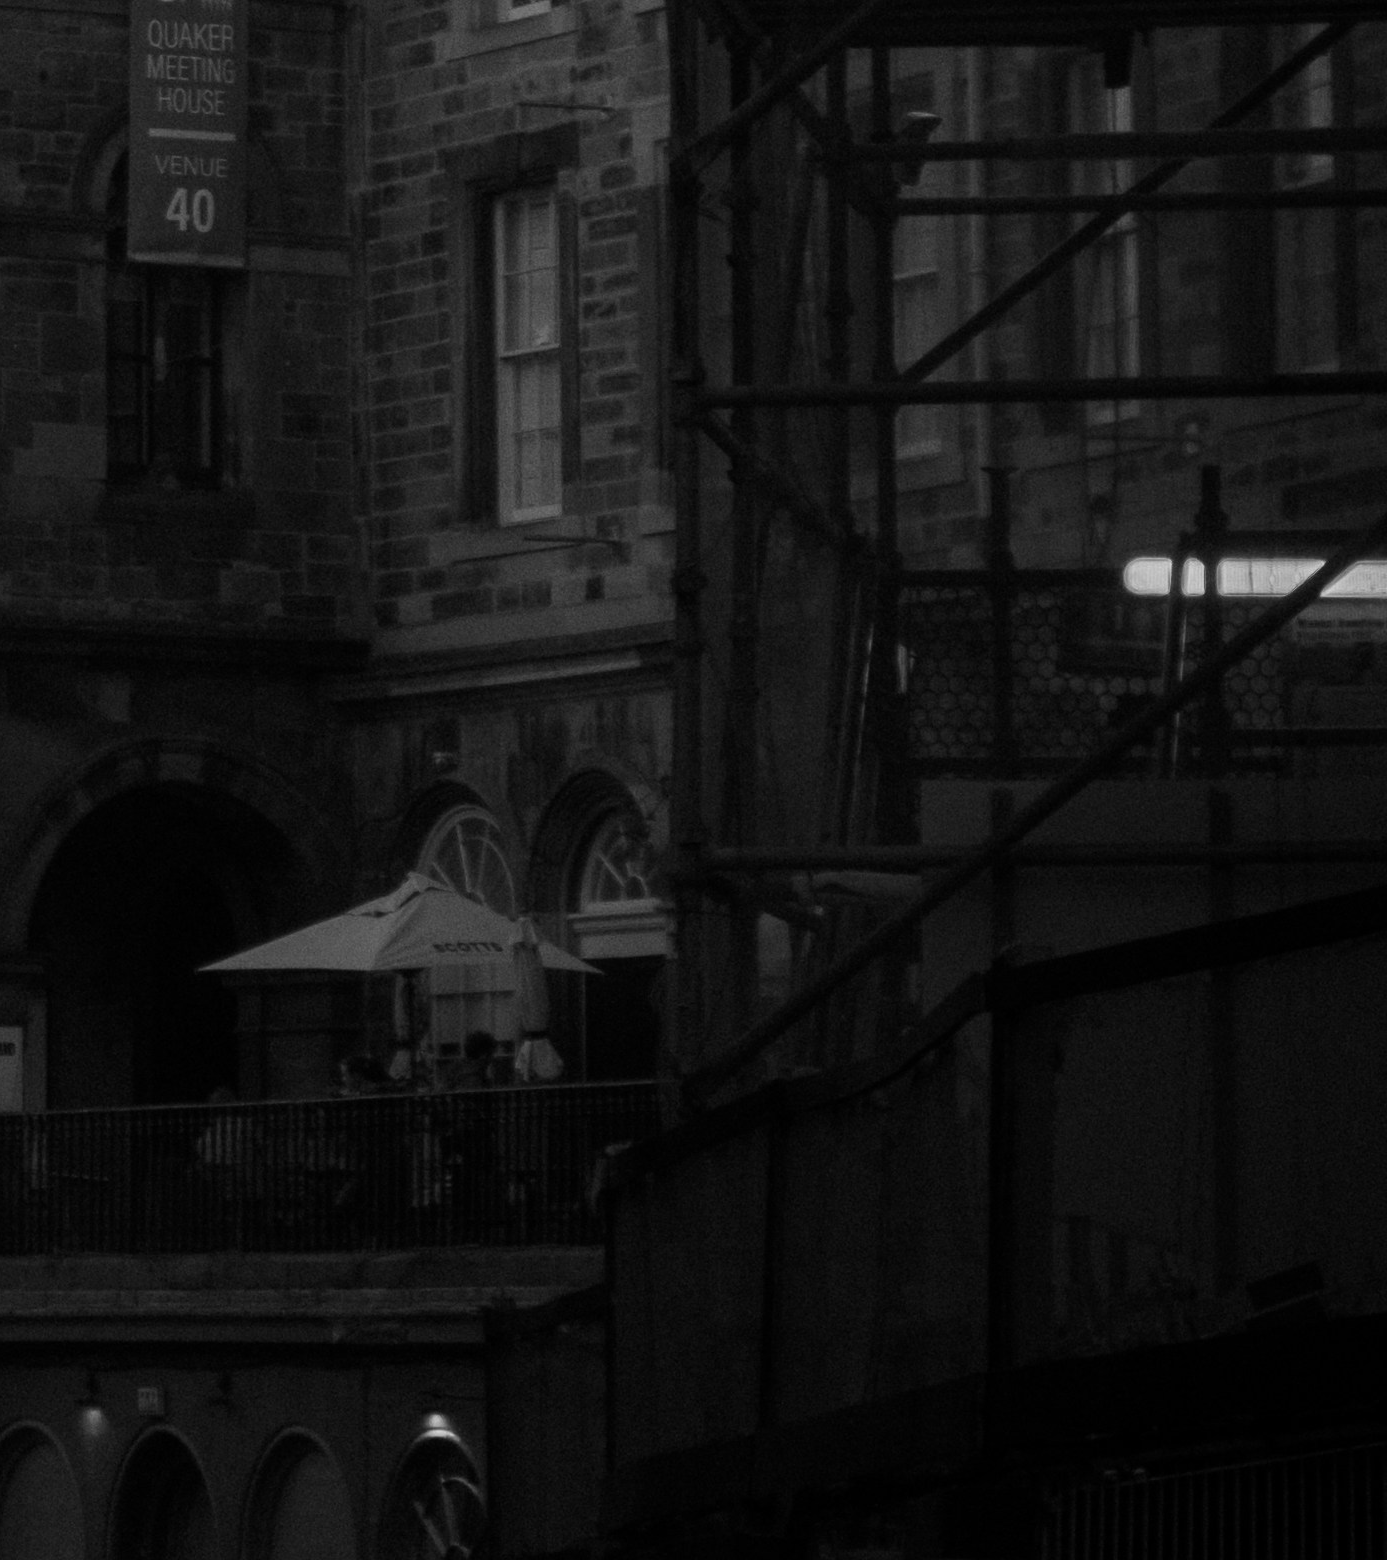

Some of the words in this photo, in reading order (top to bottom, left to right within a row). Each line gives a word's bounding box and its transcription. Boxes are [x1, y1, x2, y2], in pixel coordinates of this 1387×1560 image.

[146, 19, 235, 51] QUAKER
[146, 53, 236, 84] MEETING
[157, 87, 226, 116] HOUSE
[153, 154, 228, 179] VENUE
[165, 187, 215, 233] 40
[433, 941, 503, 953] SCOTTS
